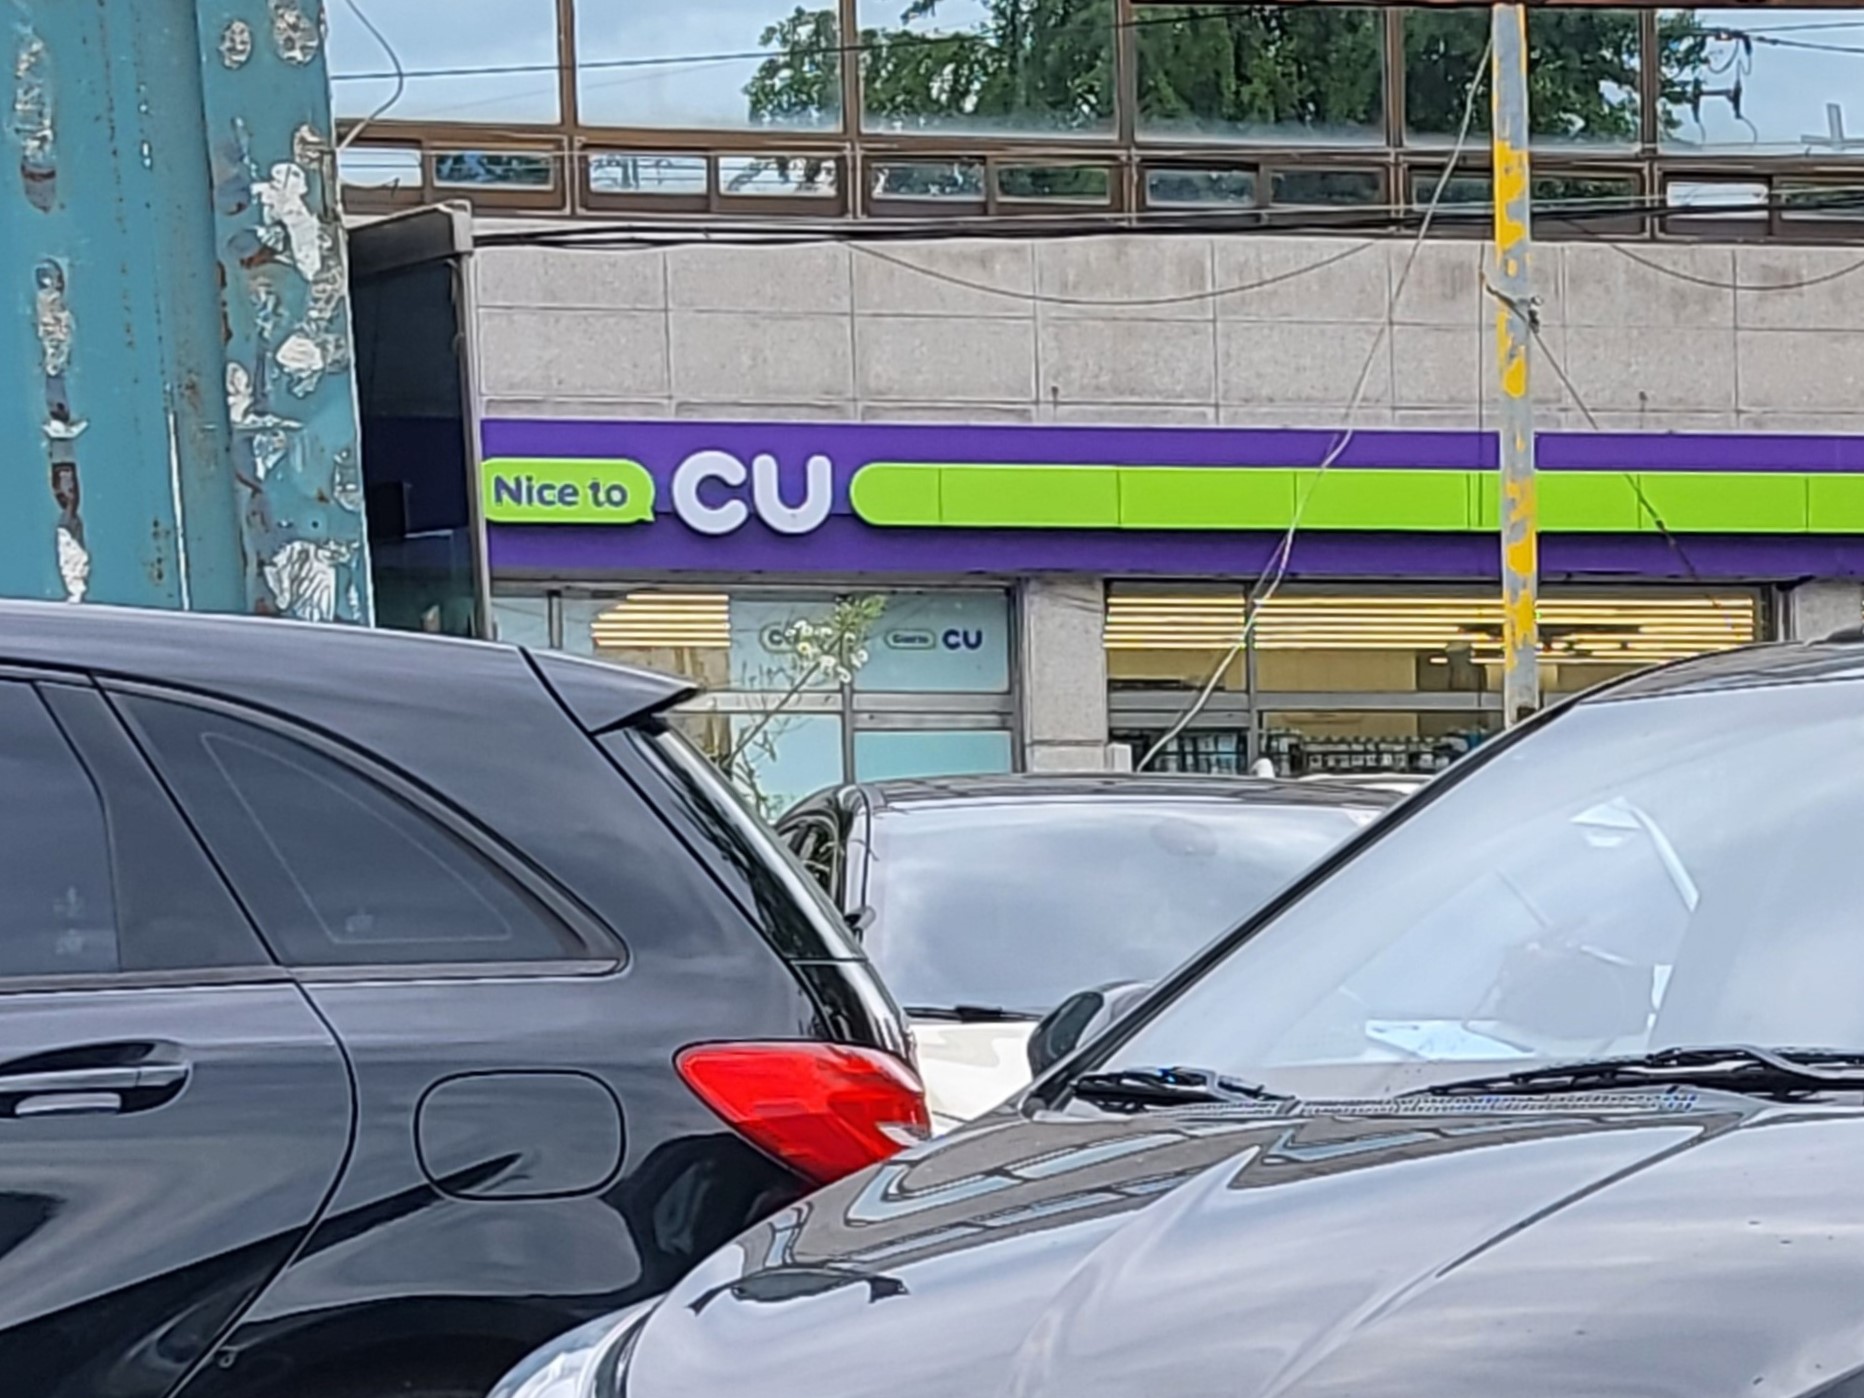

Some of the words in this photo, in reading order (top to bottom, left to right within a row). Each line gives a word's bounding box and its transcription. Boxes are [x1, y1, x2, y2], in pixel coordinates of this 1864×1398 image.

[493, 475, 579, 507] Nice
[587, 477, 628, 508] to
[672, 450, 832, 534] CU
[942, 628, 983, 651] CU
